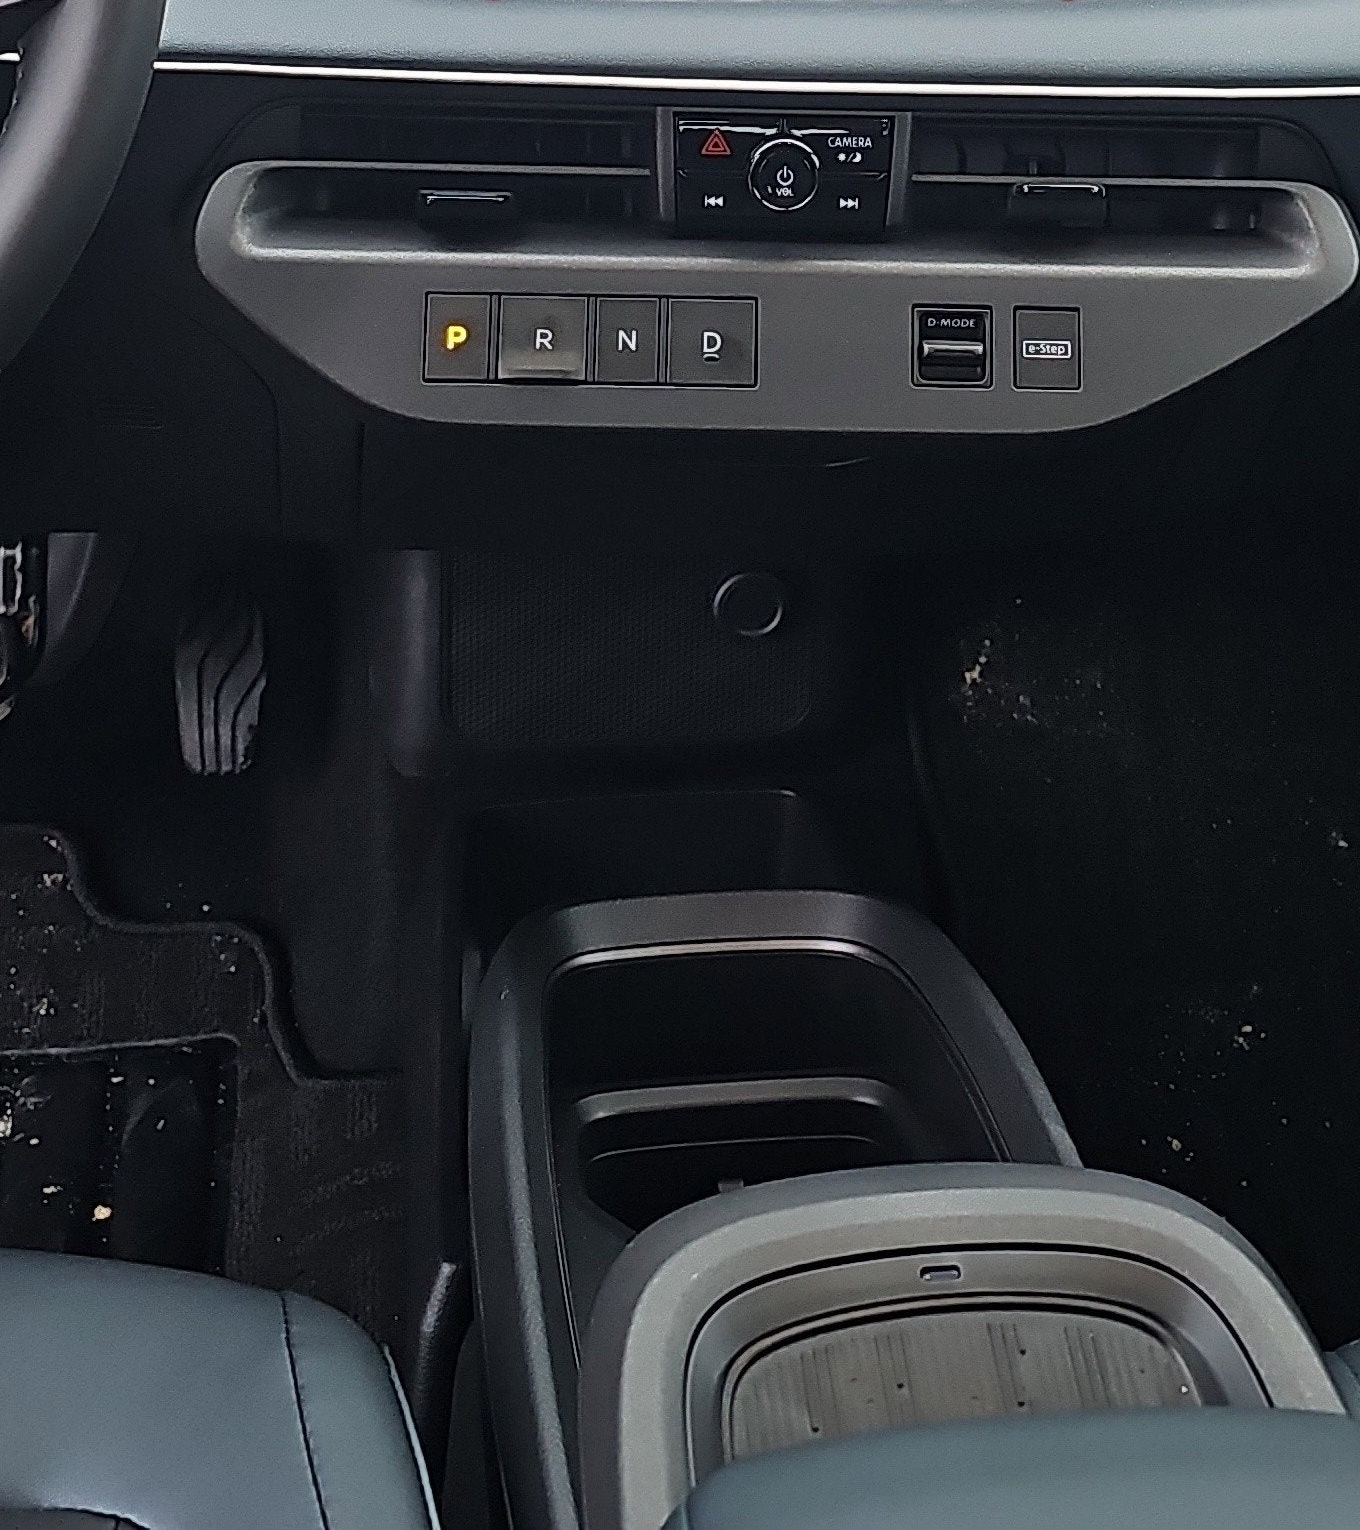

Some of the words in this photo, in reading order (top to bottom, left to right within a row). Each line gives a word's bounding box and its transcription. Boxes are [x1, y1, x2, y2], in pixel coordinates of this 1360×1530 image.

[828, 136, 872, 148] CAMERA
[776, 187, 794, 196] VOL
[446, 326, 467, 350] P
[535, 329, 553, 349] R
[618, 330, 637, 351] N
[703, 331, 722, 353] D
[1028, 343, 1065, 356] e-Step
